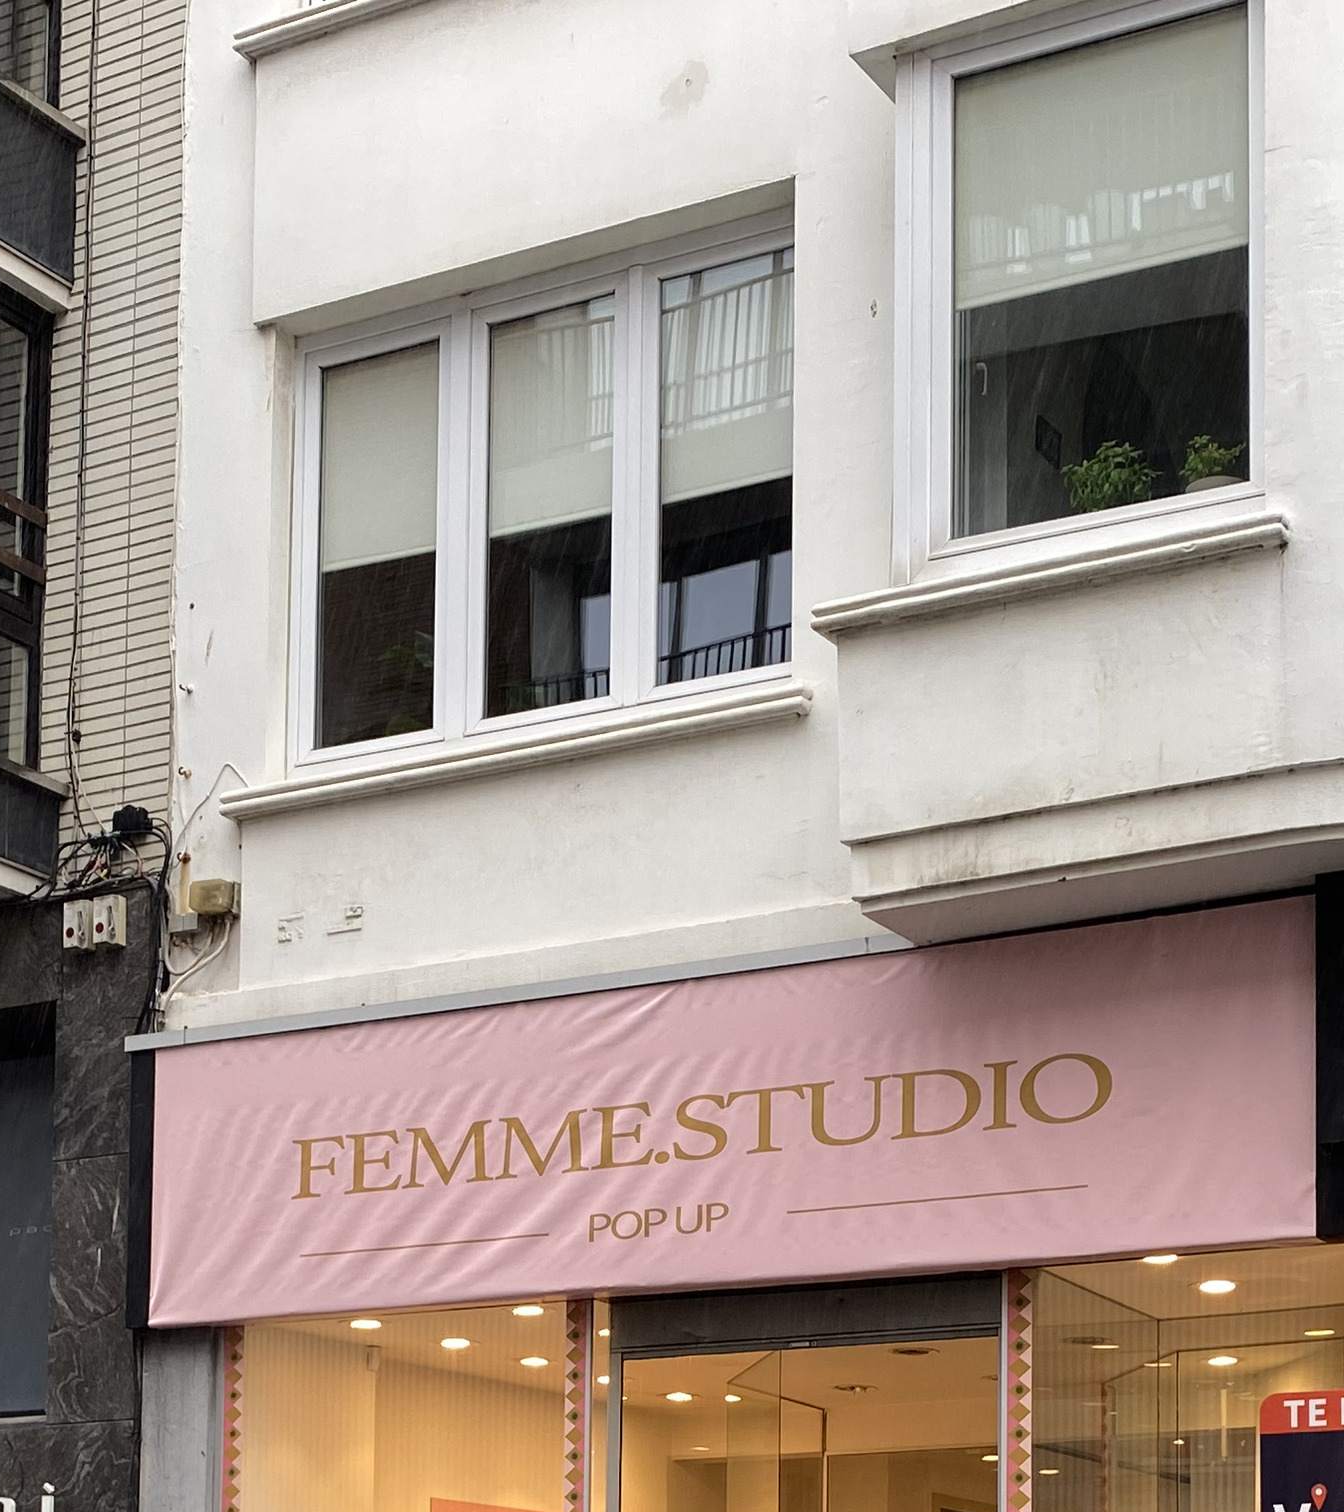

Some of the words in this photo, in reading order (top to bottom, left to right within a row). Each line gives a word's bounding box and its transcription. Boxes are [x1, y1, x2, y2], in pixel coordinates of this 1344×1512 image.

[291, 1052, 1114, 1200] FEMME.STUDIO
[589, 1208, 667, 1243] POP
[675, 1203, 730, 1236] UP
[1283, 1398, 1328, 1428] TE
